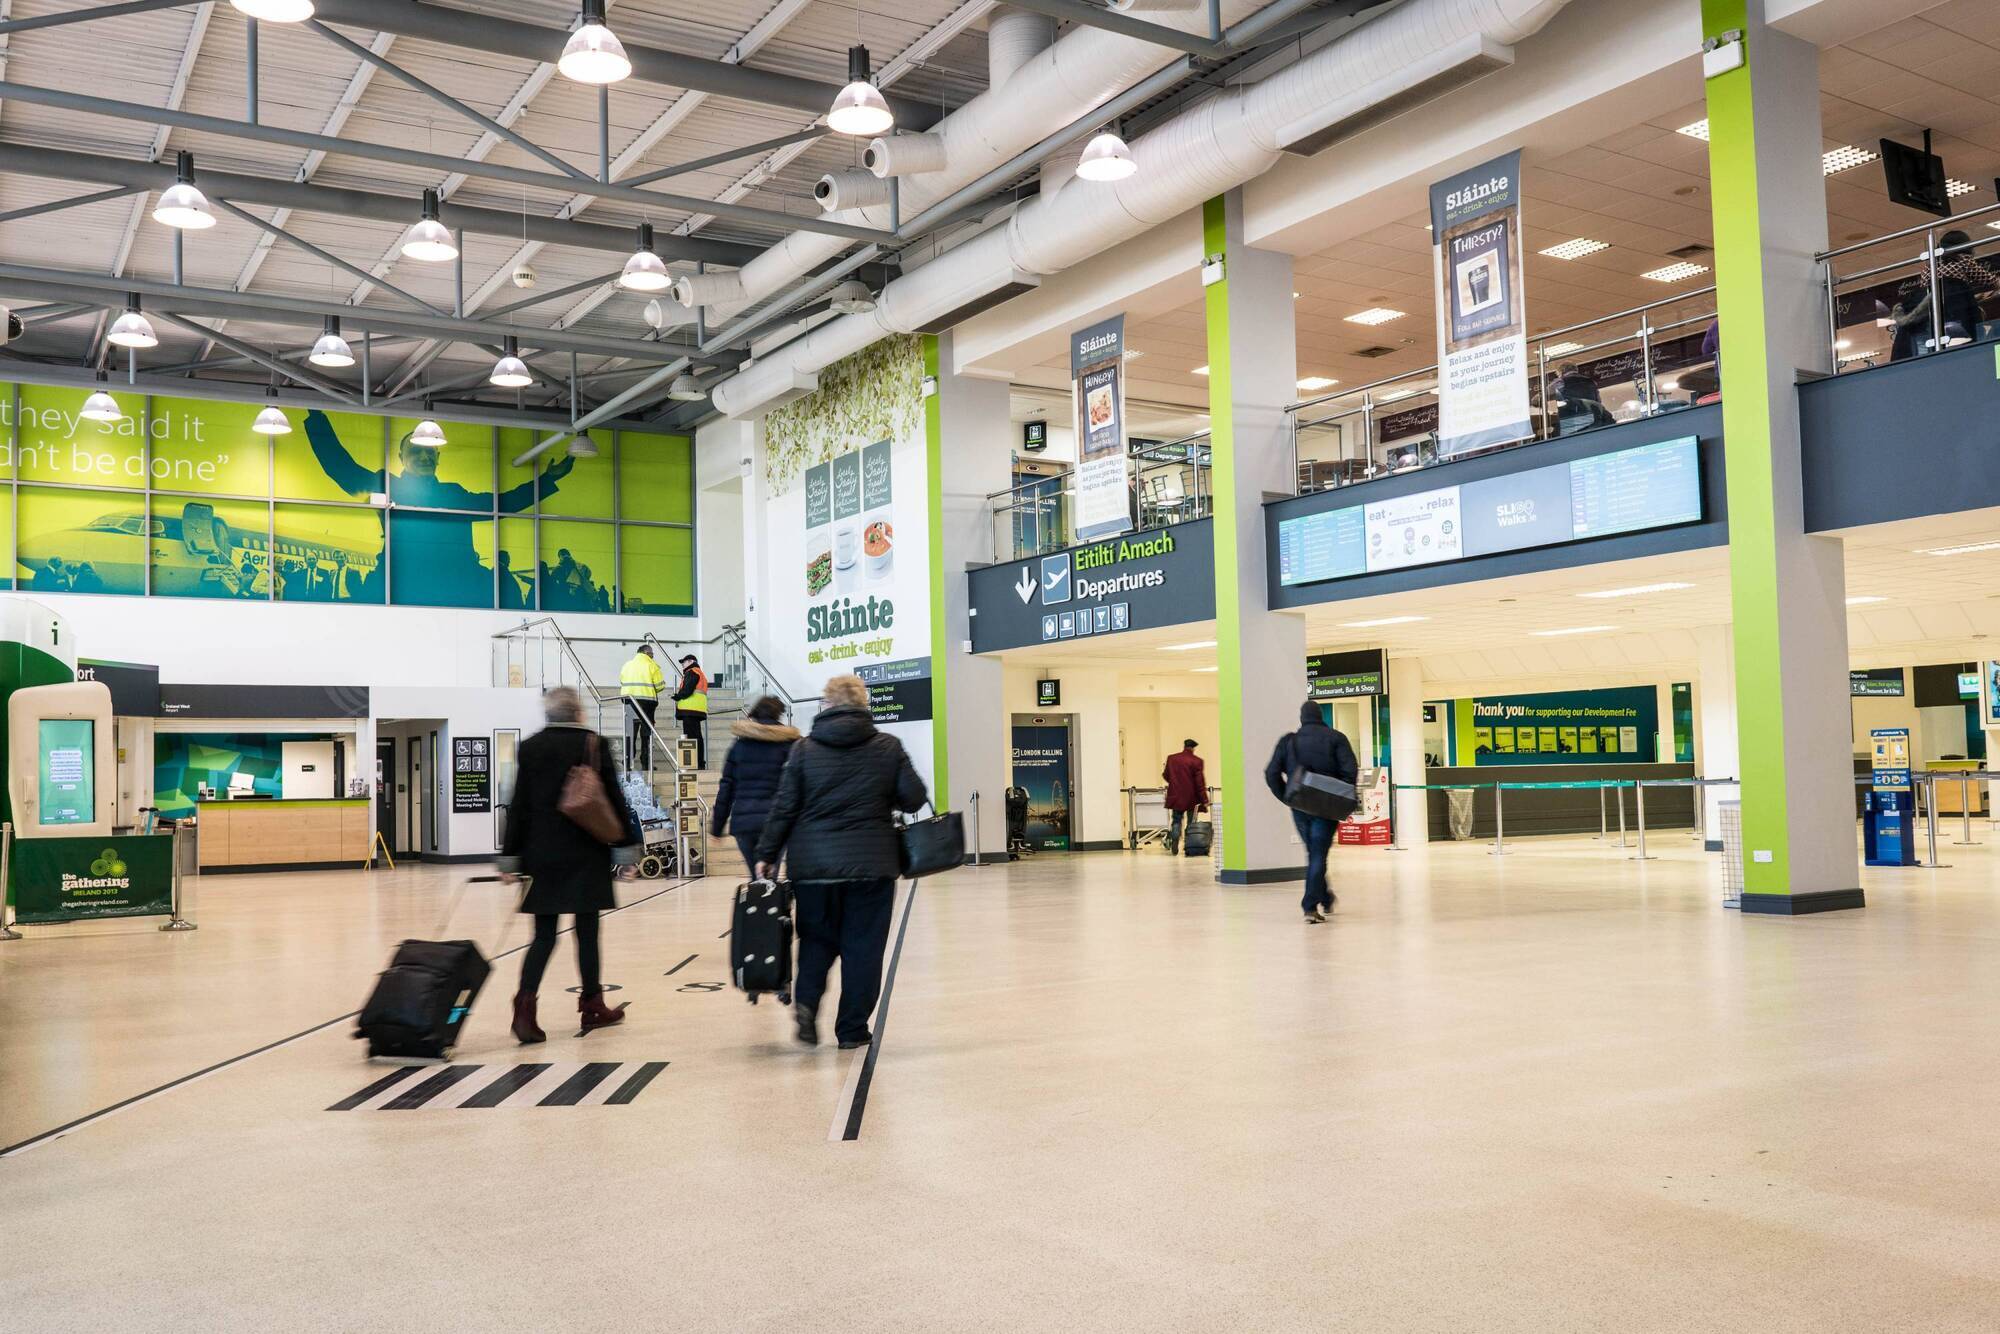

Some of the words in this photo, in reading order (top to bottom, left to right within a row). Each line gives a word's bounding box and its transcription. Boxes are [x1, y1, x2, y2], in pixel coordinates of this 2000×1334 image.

[1446, 176, 1508, 211] Sláinte
[1463, 201, 1484, 215] drink
[1488, 192, 1509, 205] enjoy
[1453, 224, 1503, 254] THIRSTY?
[1080, 332, 1117, 355] Sláinte
[1449, 354, 1472, 367] Relax
[1474, 348, 1490, 360] and
[1492, 342, 1516, 355] enjoy
[1450, 370, 1459, 378] as
[1460, 364, 1480, 377] your
[1481, 354, 1515, 372] journey
[1085, 368, 1115, 389] HUNGRY?
[1450, 377, 1478, 390] begins
[1479, 367, 1515, 383] upstairs
[1, 398, 83, 439] they
[183, 413, 205, 442] it
[72, 443, 116, 475] be
[1369, 509, 1386, 521] eat
[1427, 497, 1454, 510] relax
[1075, 543, 1114, 570] Eitiltí
[1118, 530, 1174, 562] Amach
[1077, 569, 1165, 601] Departures
[808, 595, 894, 642] Sláinte
[808, 649, 824, 664] eat
[830, 641, 858, 661] drink
[864, 637, 893, 657] enjoy
[1355, 685, 1360, 693] &
[1360, 684, 1375, 693] Shop
[1473, 702, 1504, 717] Thank
[1505, 705, 1524, 719] you
[1525, 708, 1535, 717] for
[1535, 708, 1571, 719] supporting
[1572, 709, 1583, 717] our
[1584, 707, 1625, 719] Development
[1626, 708, 1637, 717] Fee
[1020, 749, 1040, 757] LONDON
[1041, 748, 1063, 756] CALLING
[61, 877, 130, 891] gathering
[61, 899, 129, 908] thegatheringireland.com
